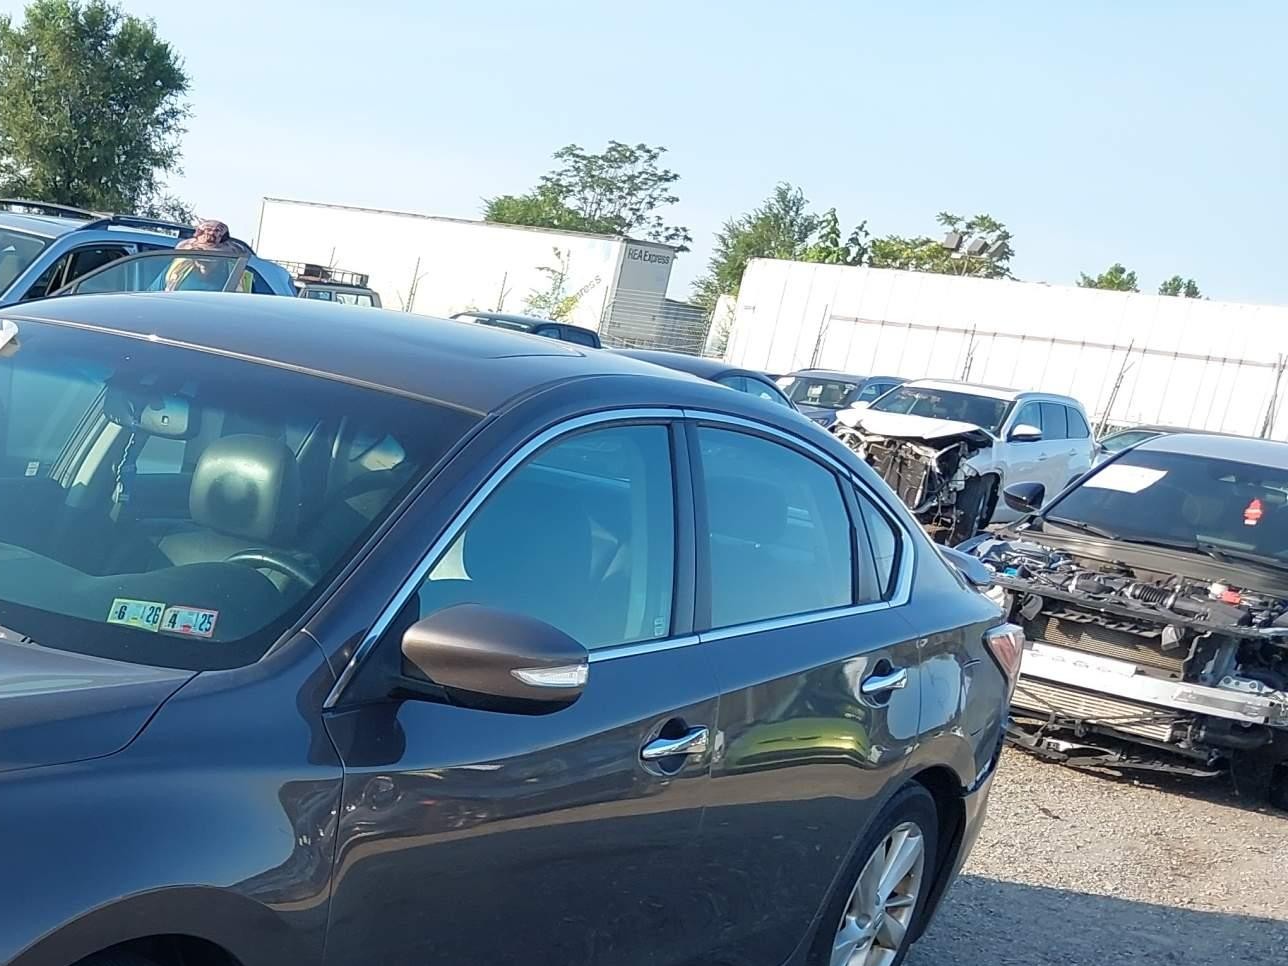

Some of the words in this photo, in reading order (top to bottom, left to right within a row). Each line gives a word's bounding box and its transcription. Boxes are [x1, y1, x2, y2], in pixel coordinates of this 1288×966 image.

[643, 250, 670, 265] Express
[117, 605, 128, 620] 6
[145, 605, 162, 624] 26
[168, 613, 178, 629] 4
[198, 613, 214, 632] 25
